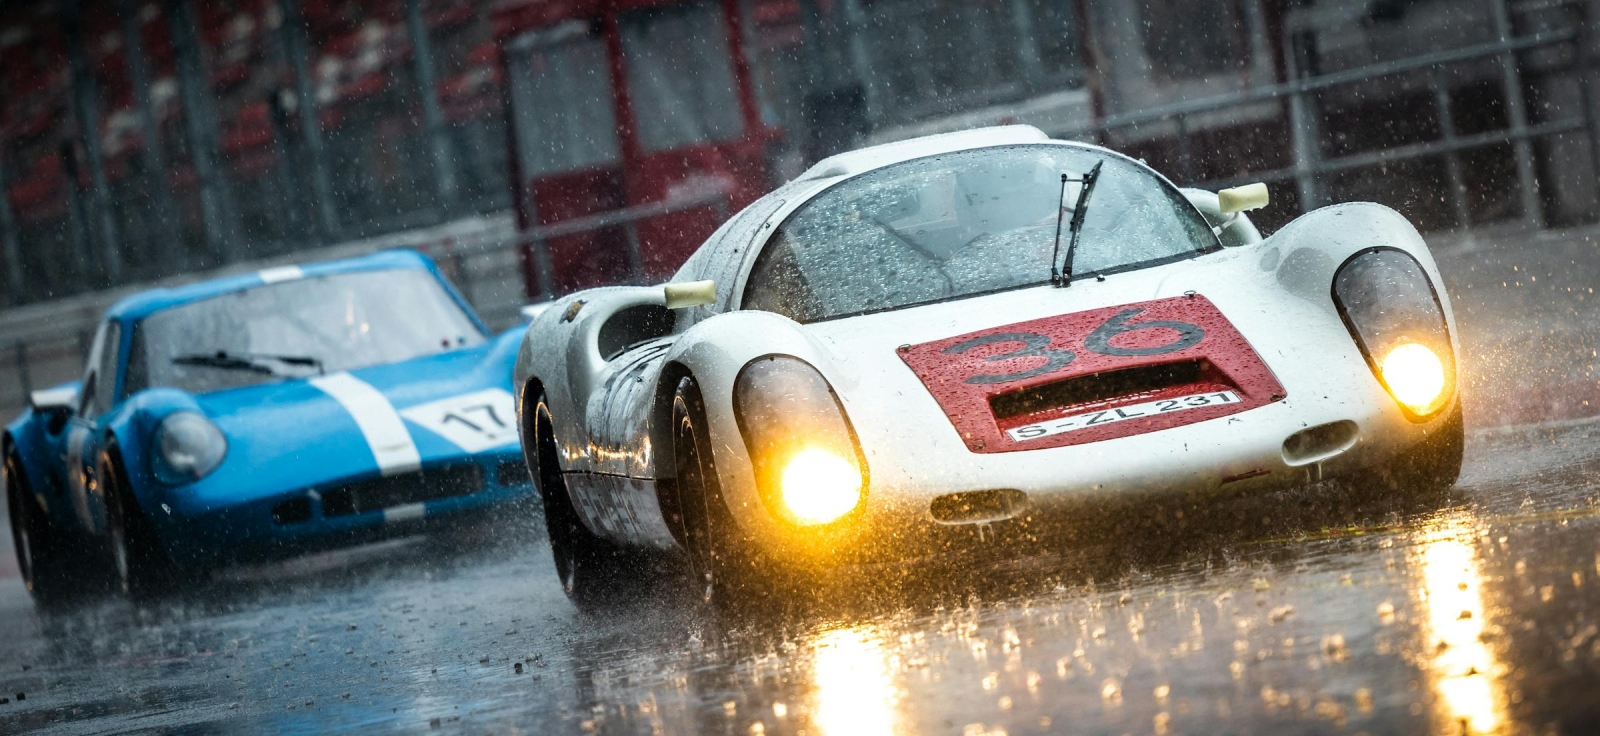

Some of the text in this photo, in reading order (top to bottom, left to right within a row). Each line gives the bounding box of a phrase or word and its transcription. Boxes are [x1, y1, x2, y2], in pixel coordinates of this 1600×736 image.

[942, 307, 1205, 384] 36
[1155, 392, 1232, 412] 231
[441, 404, 506, 438] 17
